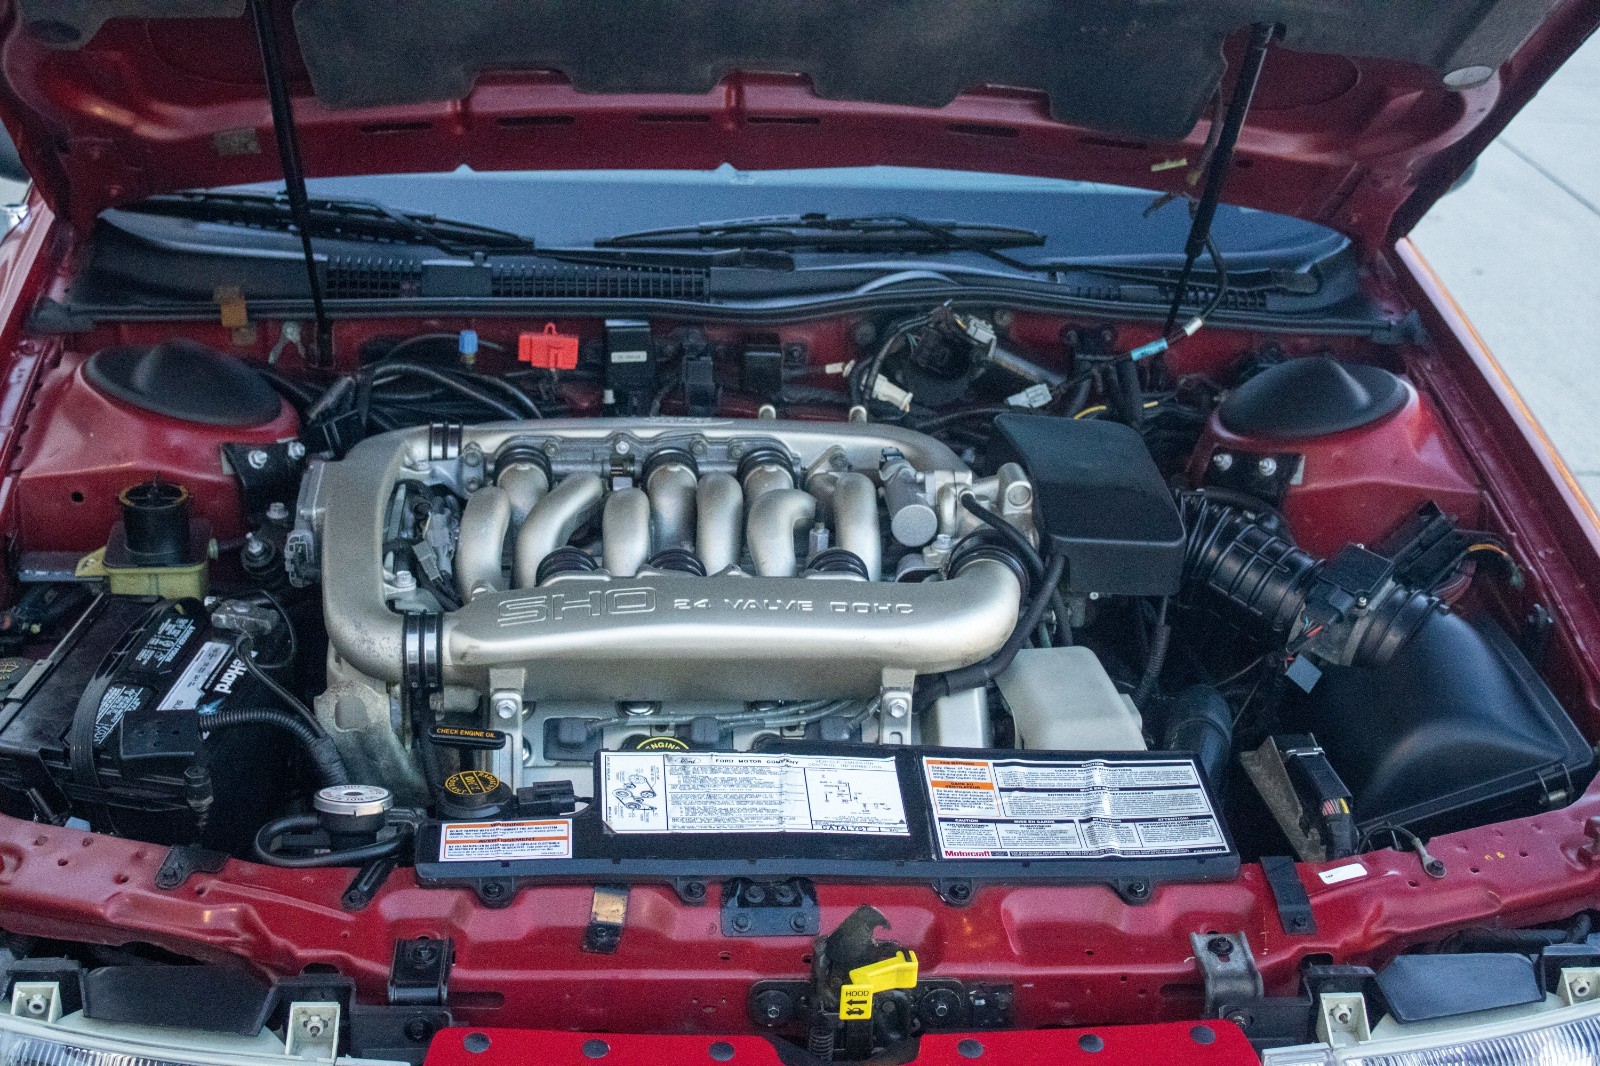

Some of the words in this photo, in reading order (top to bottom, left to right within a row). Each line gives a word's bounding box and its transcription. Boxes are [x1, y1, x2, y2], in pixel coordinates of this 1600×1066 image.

[497, 586, 657, 627] SHO
[673, 598, 712, 610] 24
[724, 599, 814, 612] VALVE
[829, 600, 914, 614] DOHC
[460, 729, 485, 738] ENGINE
[821, 824, 870, 832] CATALYST
